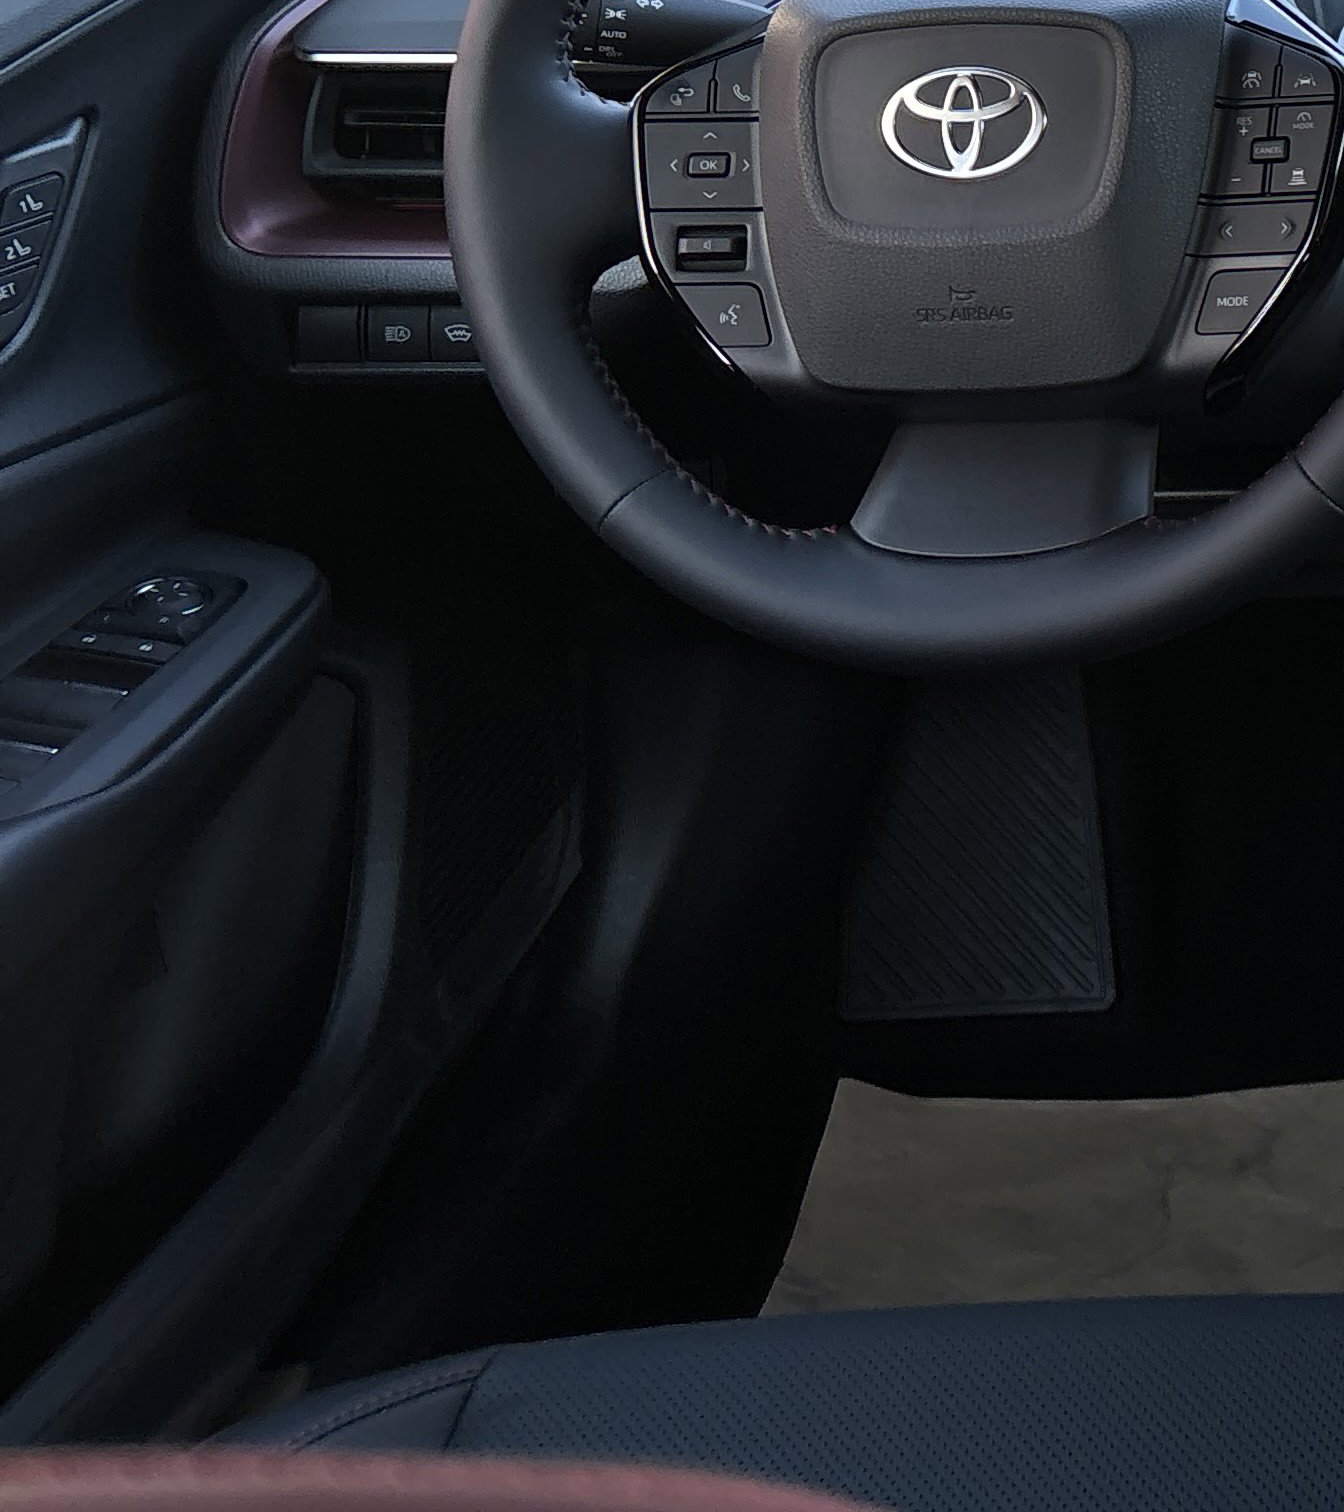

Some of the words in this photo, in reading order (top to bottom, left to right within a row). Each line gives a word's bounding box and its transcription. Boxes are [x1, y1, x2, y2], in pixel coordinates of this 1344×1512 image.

[600, 30, 627, 39] AUTO
[1292, 122, 1315, 130] MODE
[699, 159, 717, 171] OK
[4, 246, 17, 261] 2
[0, 282, 16, 300] ET
[1216, 295, 1249, 308] MODE
[916, 307, 947, 323] SRS
[950, 306, 1013, 322] AIRBAG
